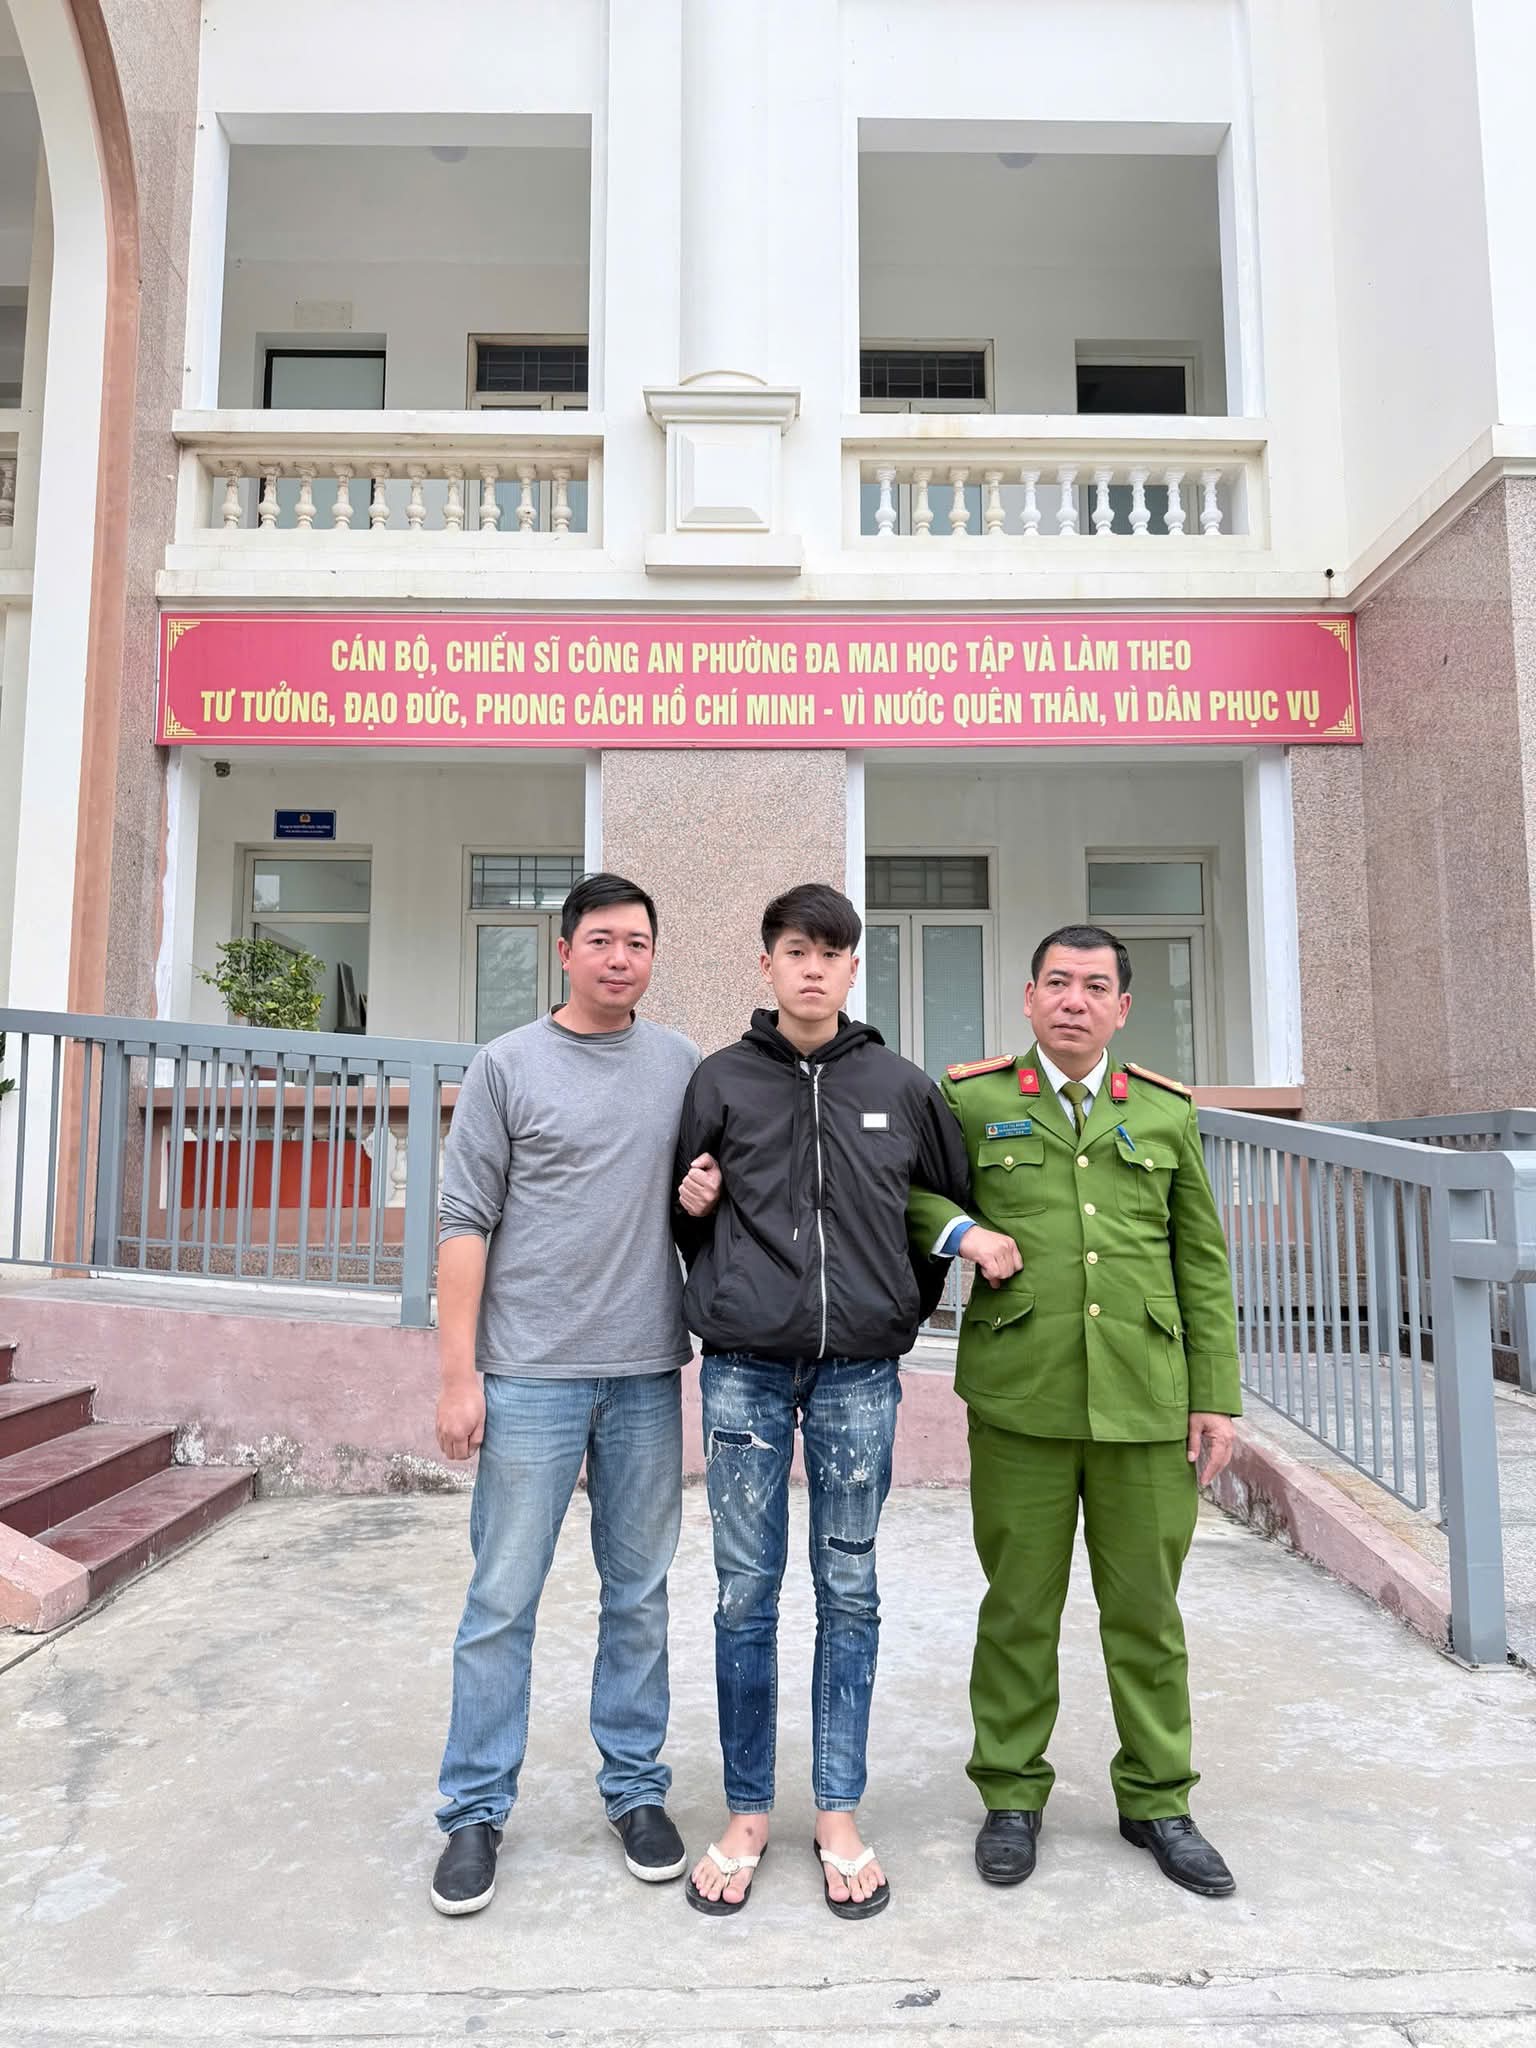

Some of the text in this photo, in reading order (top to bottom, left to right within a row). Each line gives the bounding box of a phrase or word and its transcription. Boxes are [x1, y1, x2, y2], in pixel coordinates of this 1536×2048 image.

[331, 631, 1191, 681] CÁN BỘ, CHIẾN SĨ CÔNG AN PHƯỜNG ĐA MAI HỌC TẬP VÀ LÀM THEO
[201, 680, 1320, 731] TƯ TƯỞNG, ĐẠO ĐỨC, PHONG CÁCH HỒ CHÍ MINH - VÌ NƯỚC QUÊN THÂN, VÌ DÂN PHỤC VỤ
